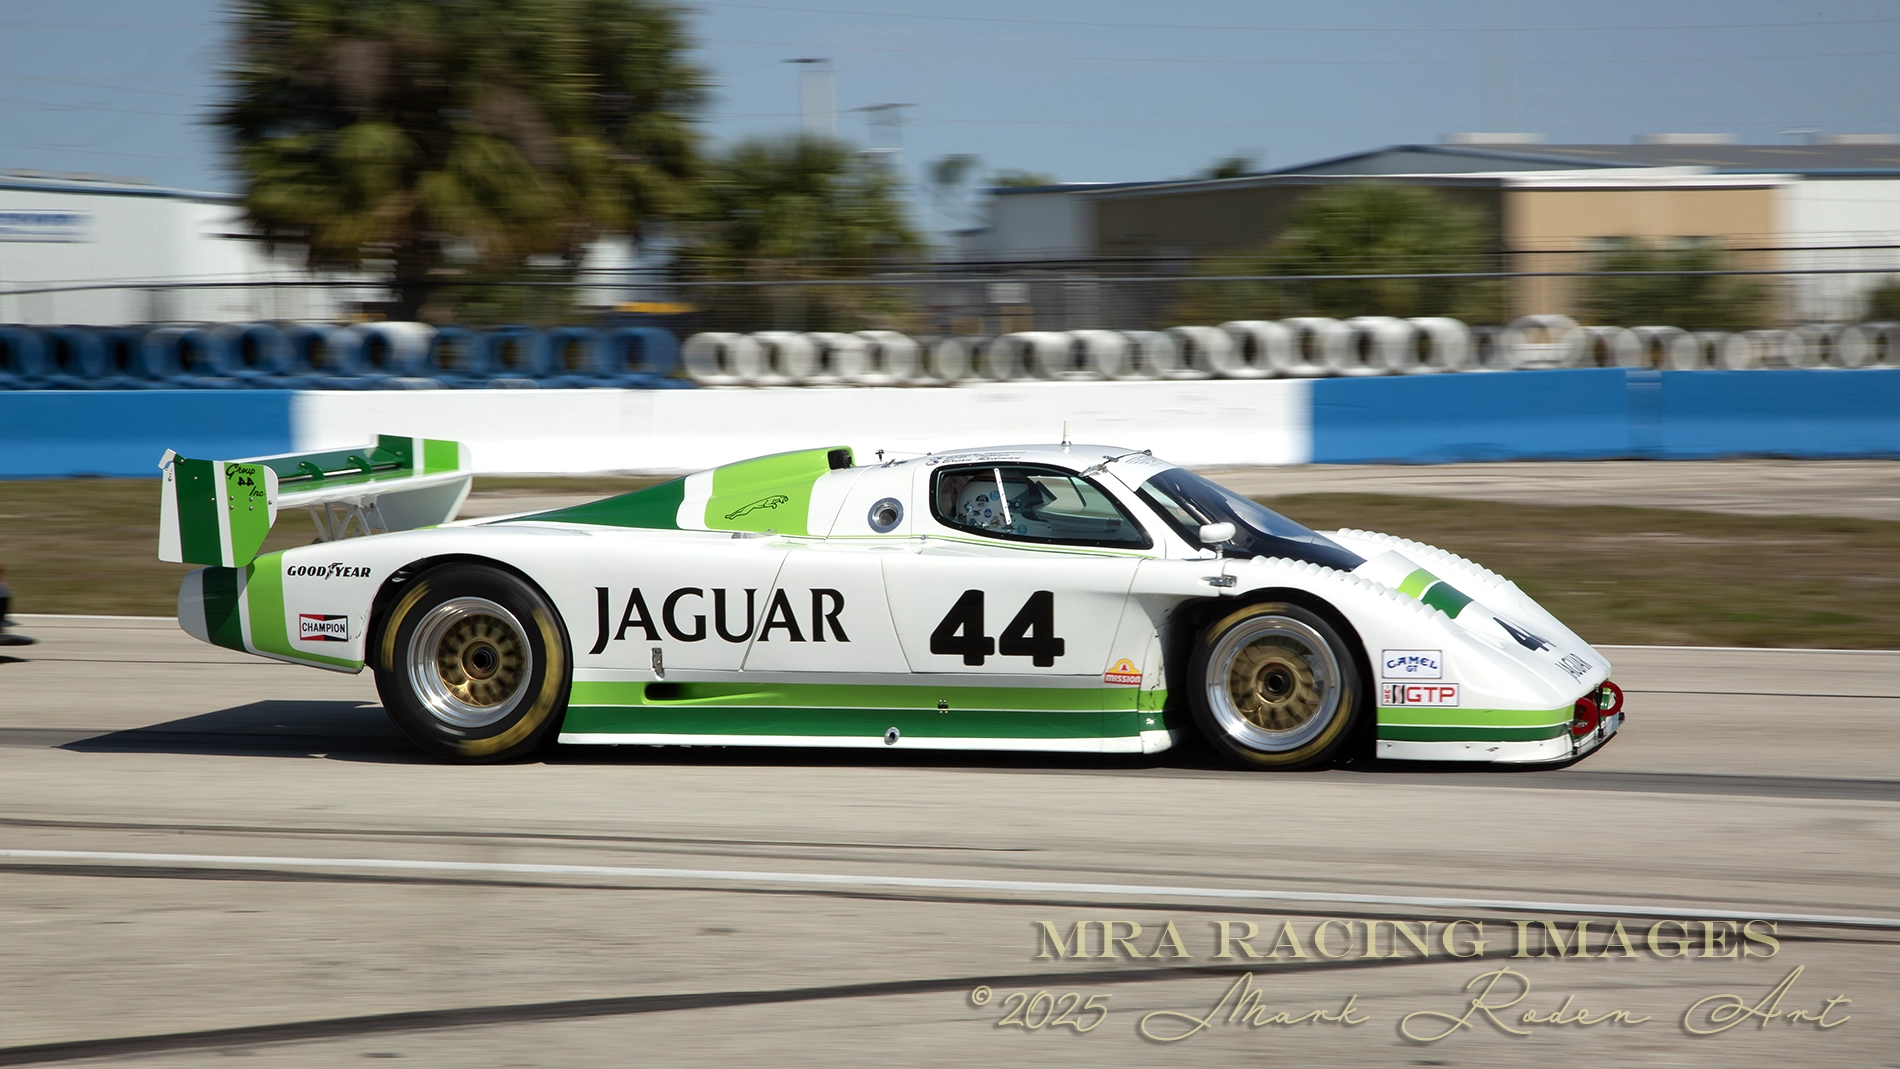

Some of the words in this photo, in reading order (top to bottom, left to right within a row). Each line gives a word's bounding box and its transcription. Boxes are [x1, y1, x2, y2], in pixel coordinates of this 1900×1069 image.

[226, 463, 256, 480] Group
[237, 476, 254, 486] 44
[287, 563, 371, 579] GOODYEAR
[302, 622, 346, 633] CHAMPION
[588, 586, 851, 655] JAGUAR
[930, 589, 1065, 667] 44
[1386, 656, 1438, 669] CAMEL
[1406, 686, 1455, 703] GTP
